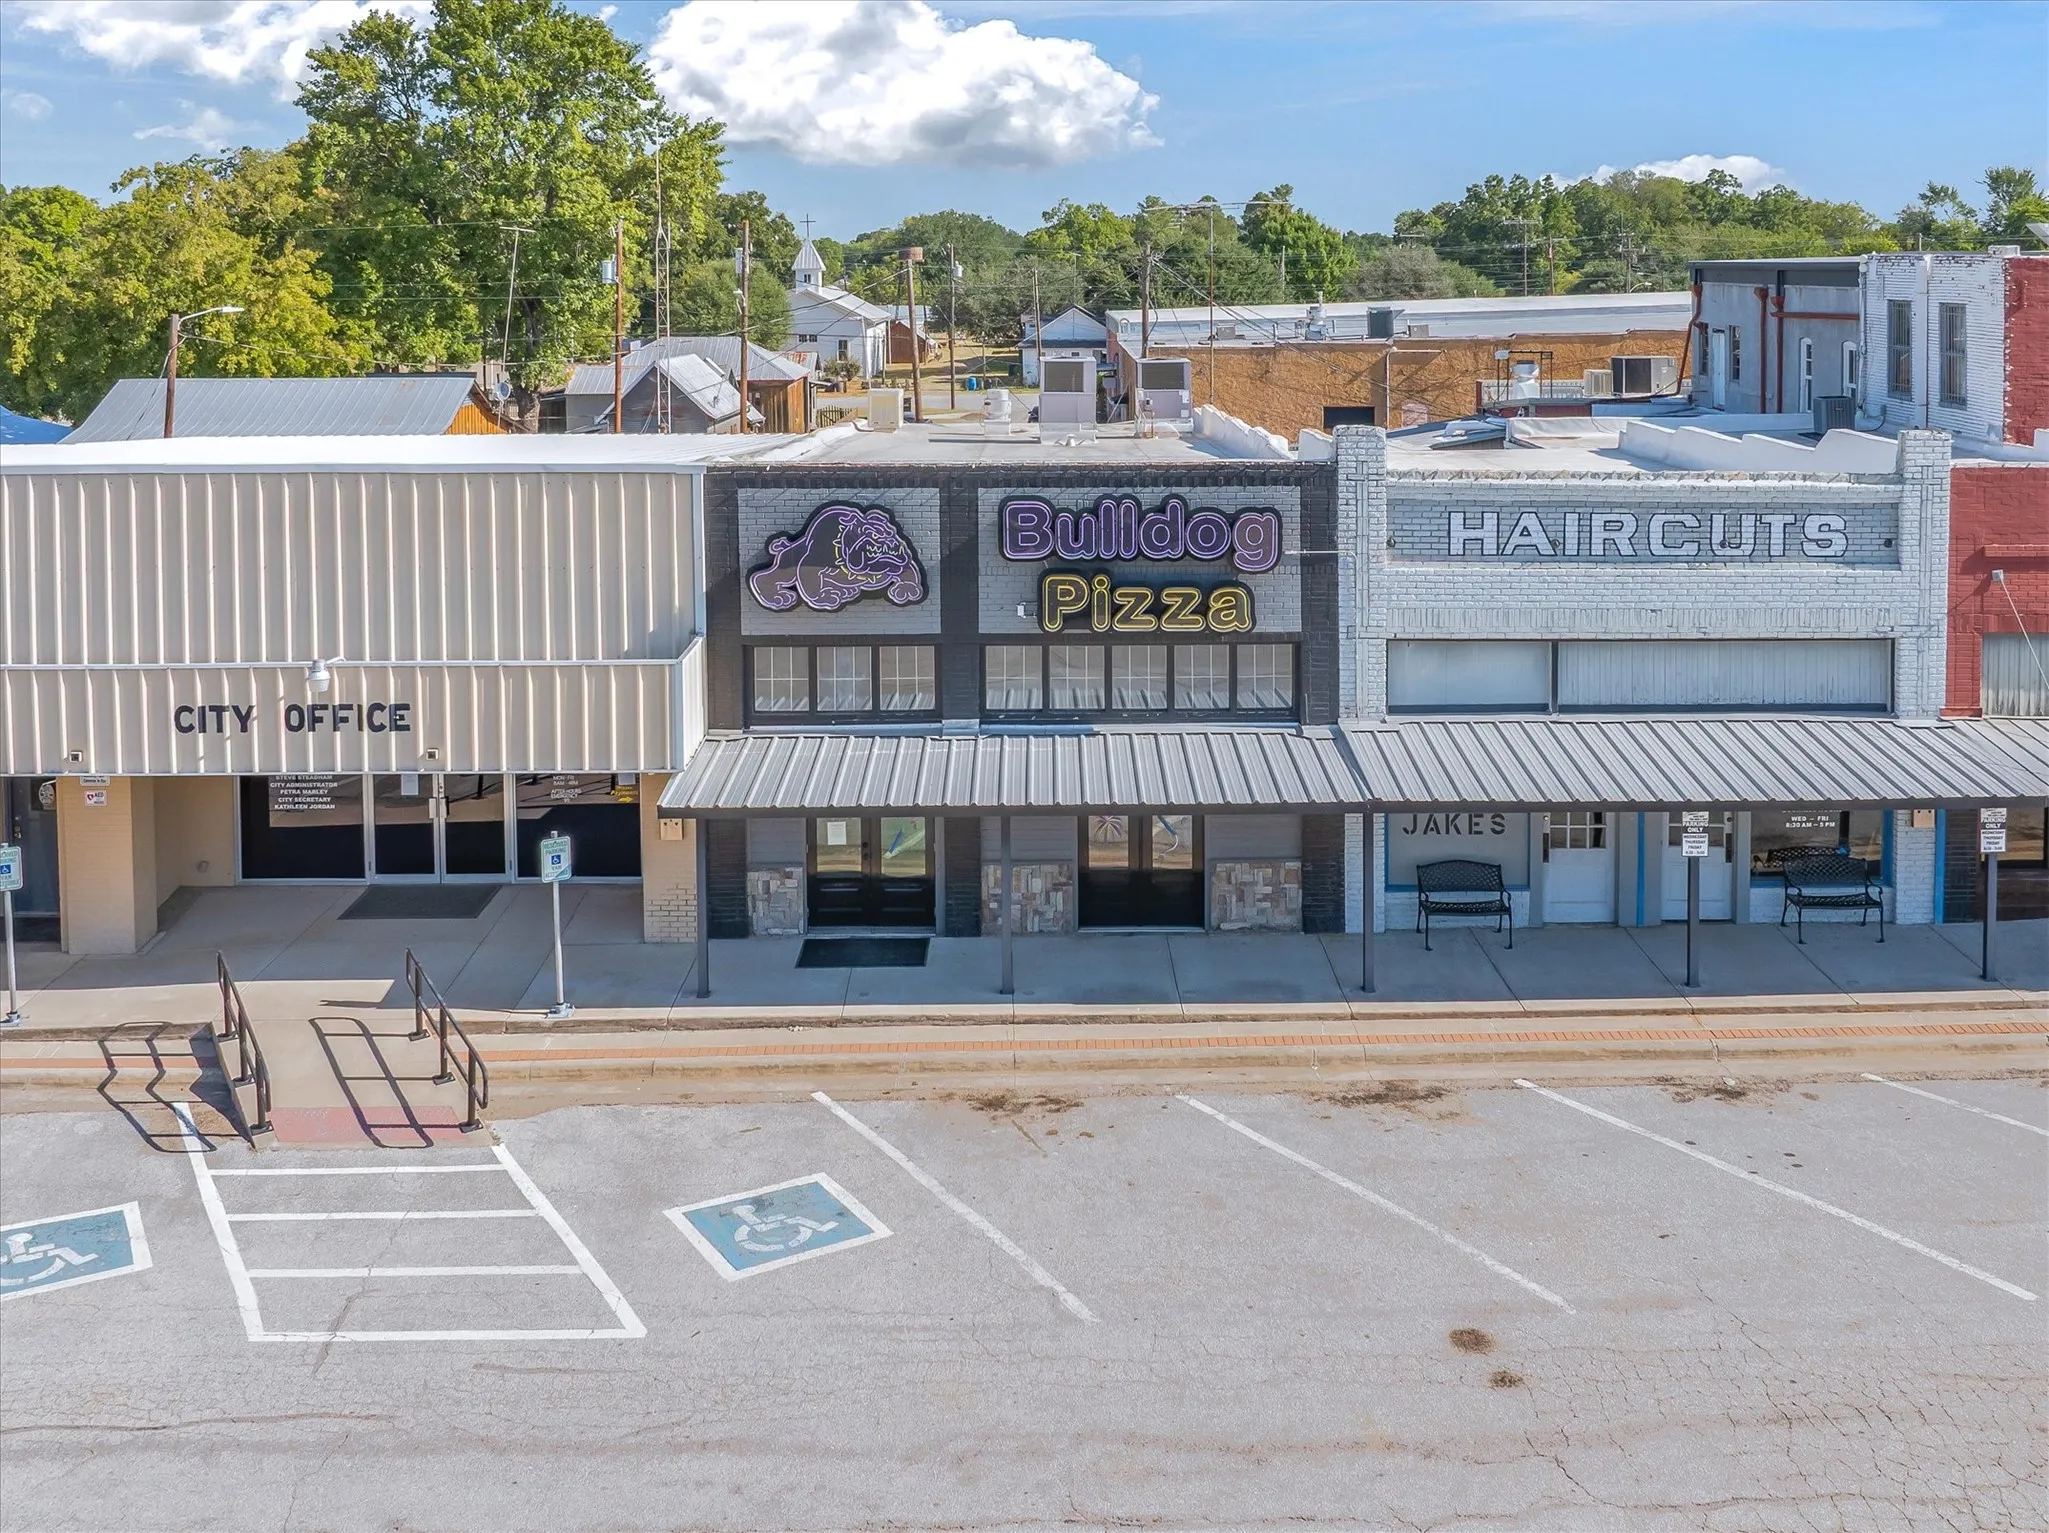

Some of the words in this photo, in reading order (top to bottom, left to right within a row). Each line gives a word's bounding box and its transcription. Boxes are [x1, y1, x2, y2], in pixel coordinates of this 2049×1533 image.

[1003, 499, 1279, 571] Bulldog
[1447, 511, 1849, 558] HAIRCUTS
[1042, 573, 1253, 632] Pizza
[174, 704, 256, 733] CITY
[285, 702, 411, 733] OFFICE
[1402, 813, 1506, 835] JAKES
